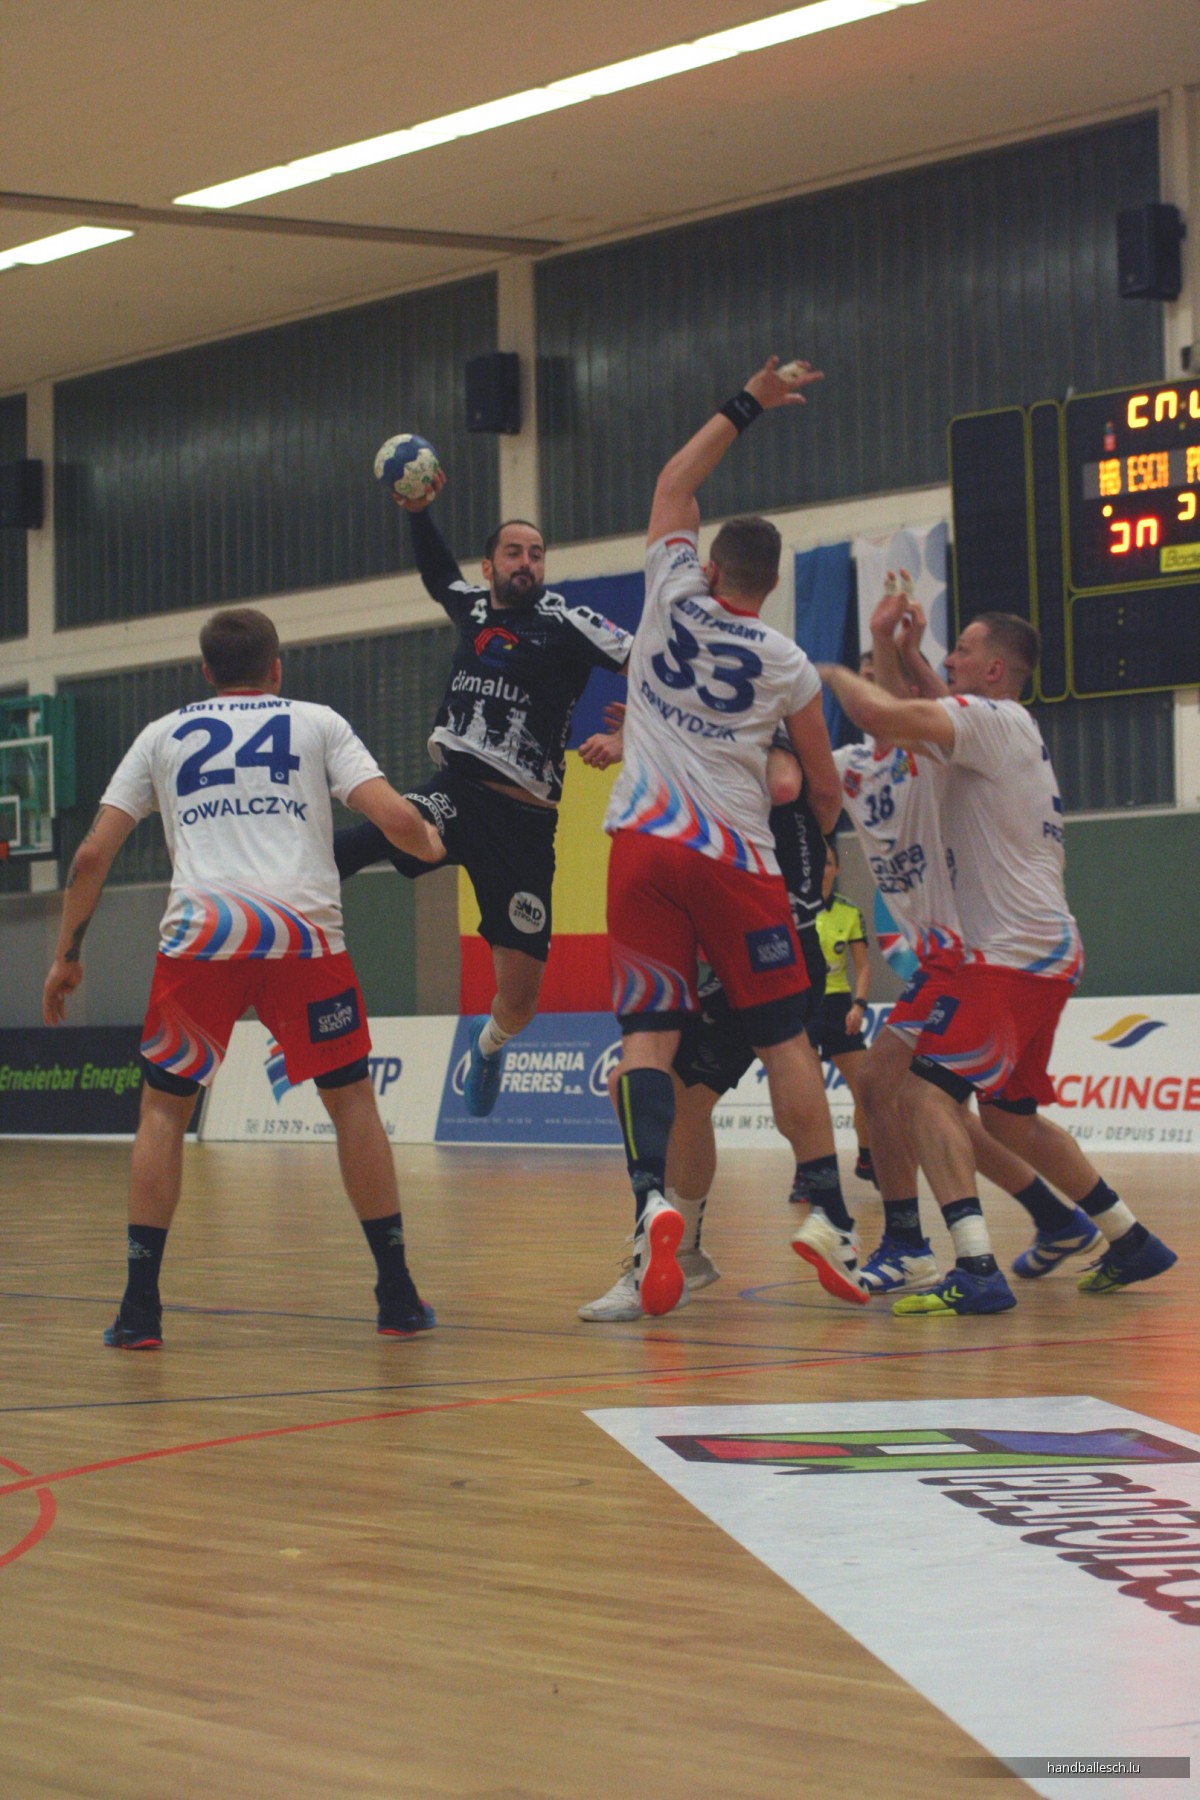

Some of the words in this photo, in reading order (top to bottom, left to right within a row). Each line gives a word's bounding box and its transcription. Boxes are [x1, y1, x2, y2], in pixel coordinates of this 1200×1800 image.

[652, 612, 764, 713] 33
[451, 669, 532, 705] dimalux
[179, 703, 225, 715] AZOTY
[171, 714, 300, 797] 24
[81, 1060, 140, 1095] Energie
[504, 1052, 585, 1071] BONARIA
[499, 1072, 564, 1093] FRERES
[1047, 1074, 1200, 1111] CKINGE
[1105, 1126, 1155, 1141] DEPUIS
[1160, 1128, 1193, 1143] 1911
